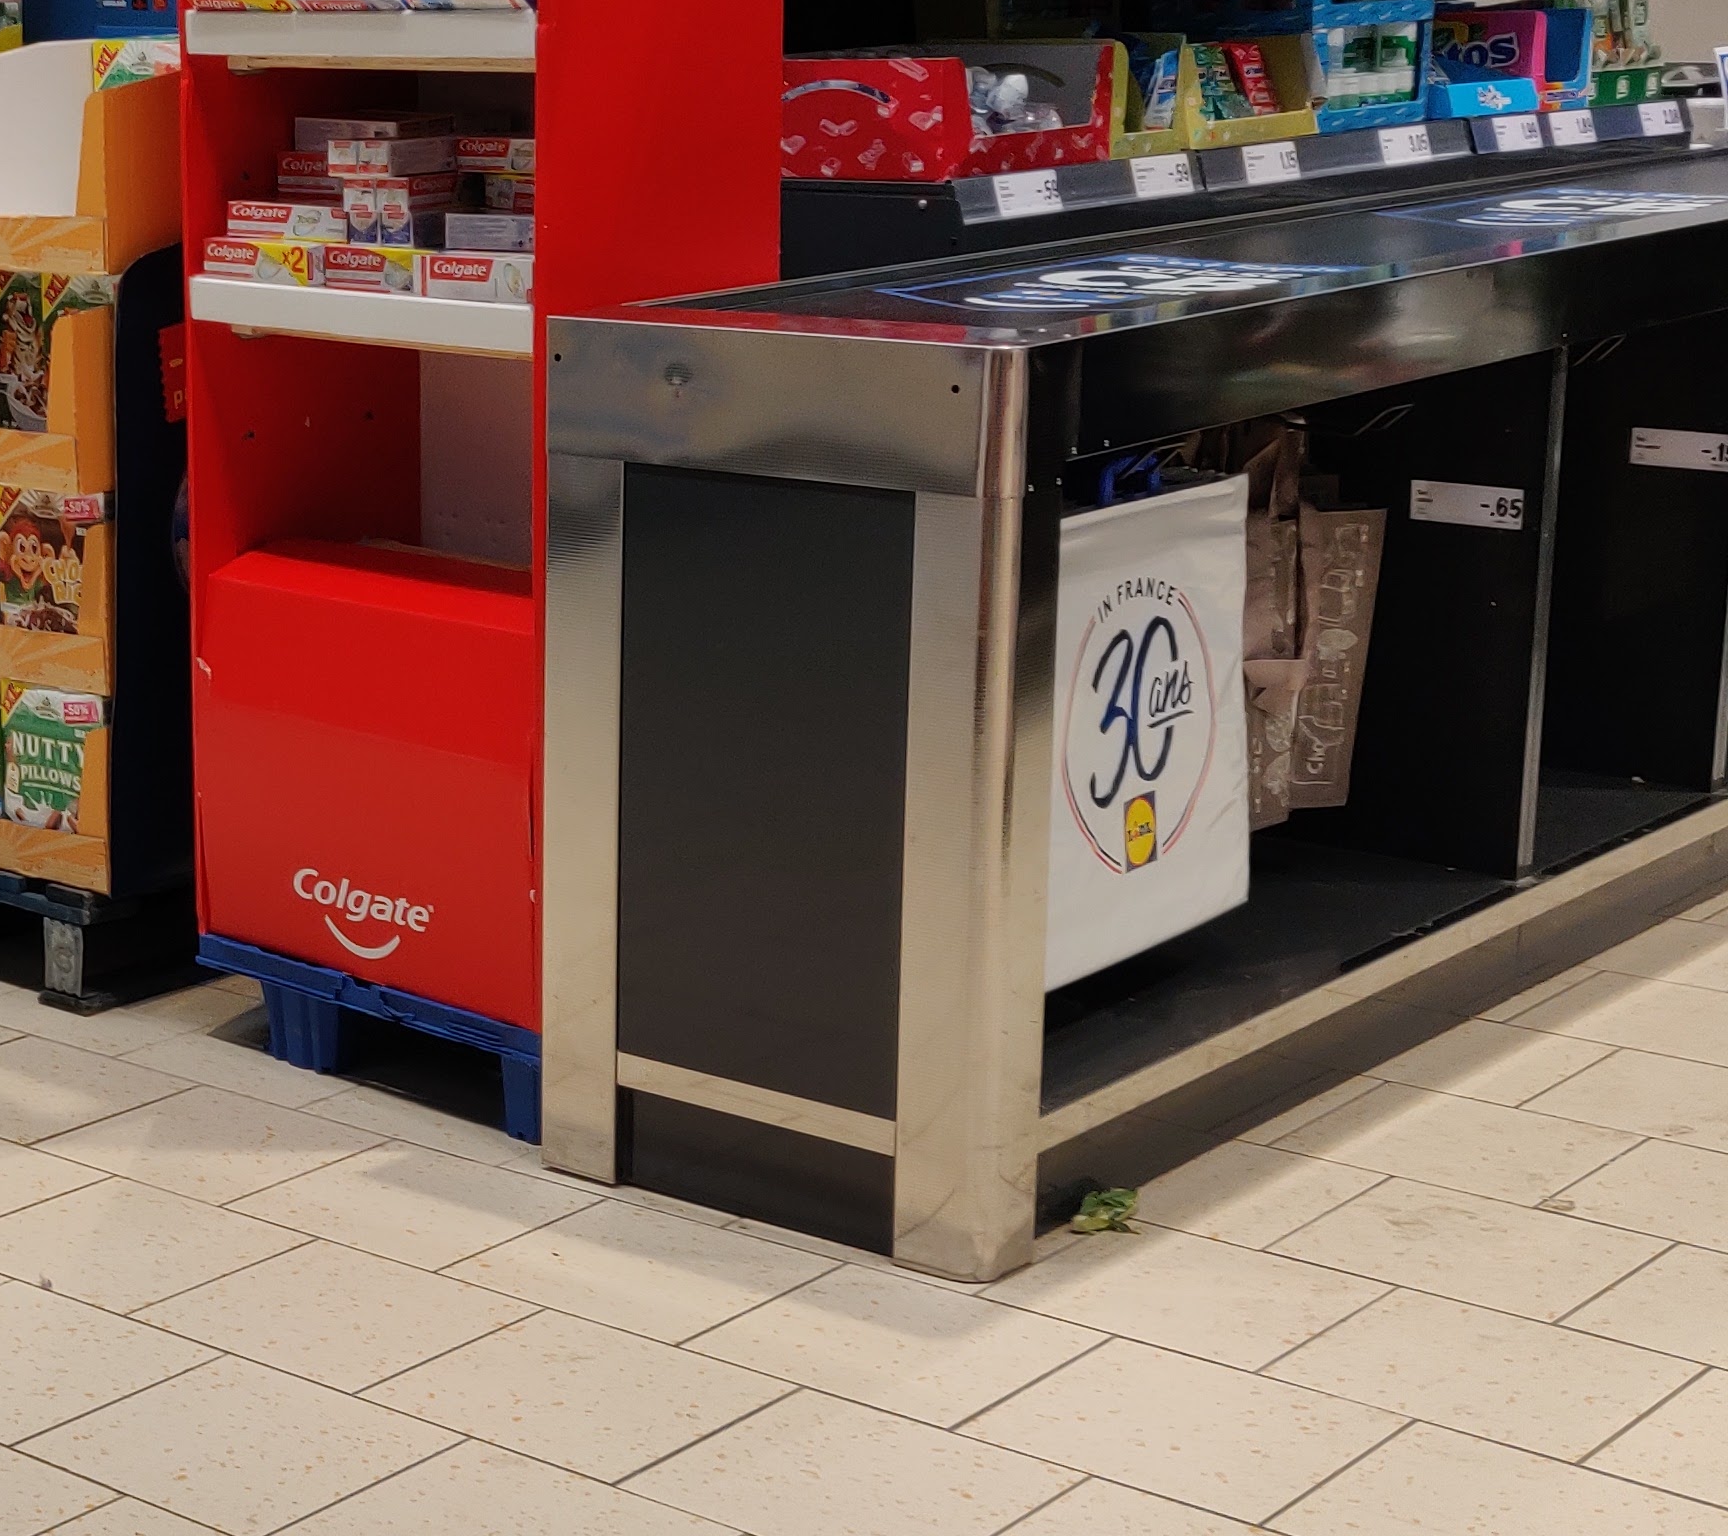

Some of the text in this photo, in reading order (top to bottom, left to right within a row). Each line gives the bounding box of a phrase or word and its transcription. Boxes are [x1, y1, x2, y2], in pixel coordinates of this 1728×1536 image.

[94, 44, 120, 78] XXL
[459, 140, 506, 153] Colgate
[231, 204, 287, 220] Colgate
[207, 243, 255, 261] Colgate
[329, 250, 382, 268] Colgate
[434, 260, 487, 278] Colgate
[1480, 496, 1523, 519] -.65
[1097, 576, 1178, 623] IN FRANCE
[1149, 660, 1195, 717] ans
[1089, 615, 1178, 809] 30
[12, 730, 84, 769] NUTTY
[22, 764, 81, 791] PILLOWS
[293, 868, 431, 933] Colgate
